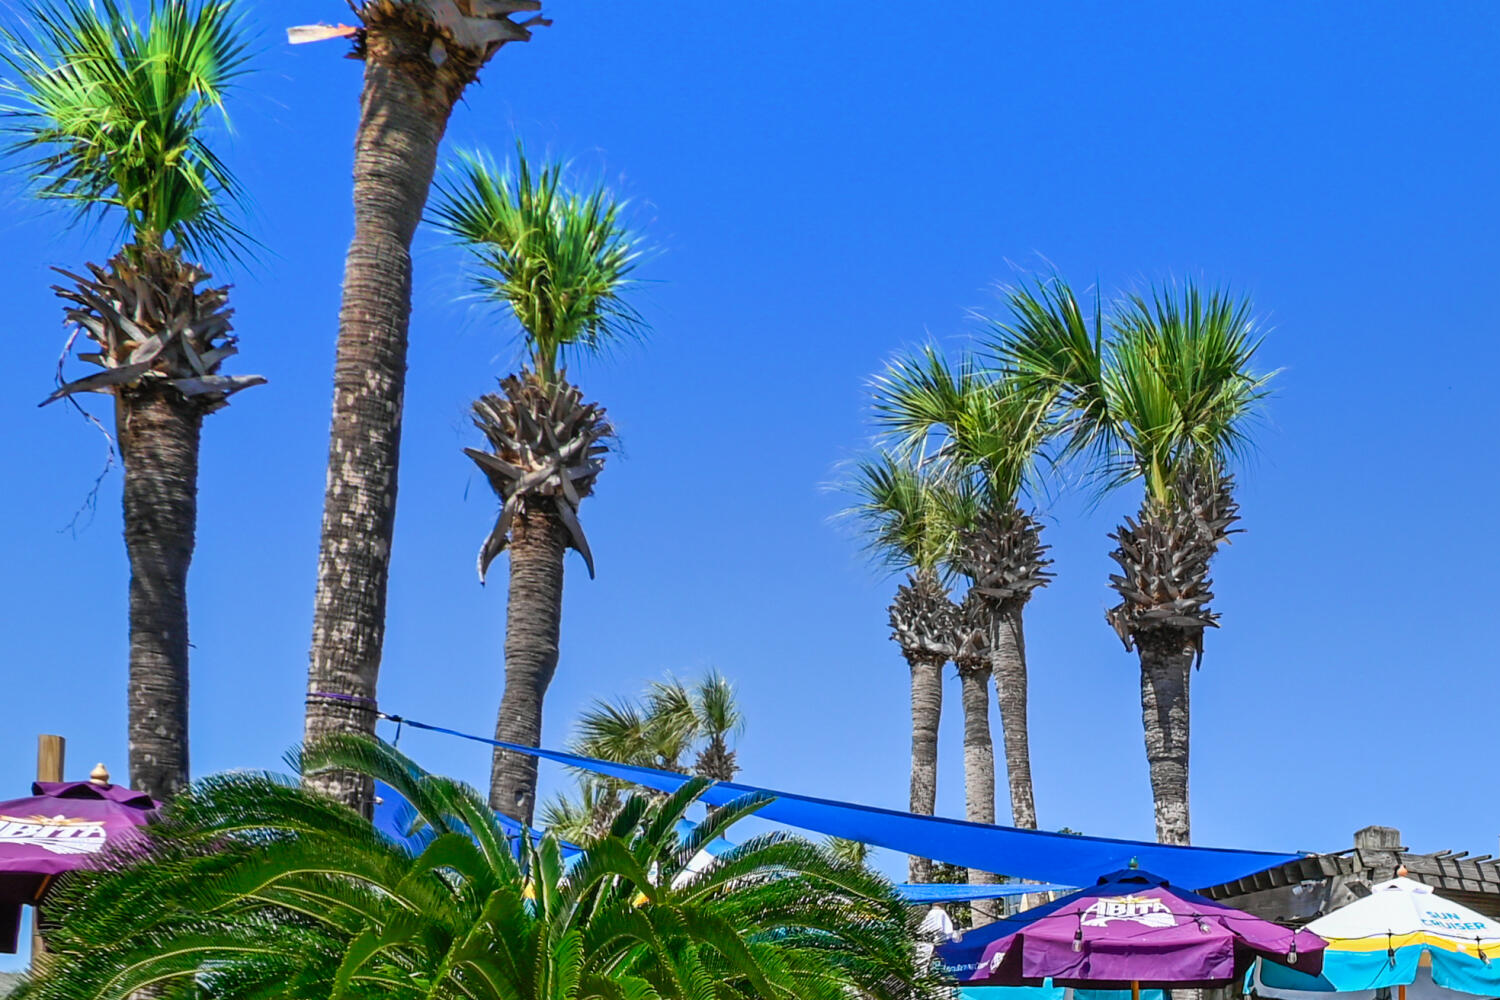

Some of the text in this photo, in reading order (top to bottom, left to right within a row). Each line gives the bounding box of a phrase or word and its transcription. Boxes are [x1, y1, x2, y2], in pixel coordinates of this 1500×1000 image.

[1081, 900, 1172, 923] ABITA
[1426, 911, 1460, 920] SUN
[1420, 919, 1487, 931] CRUISER
